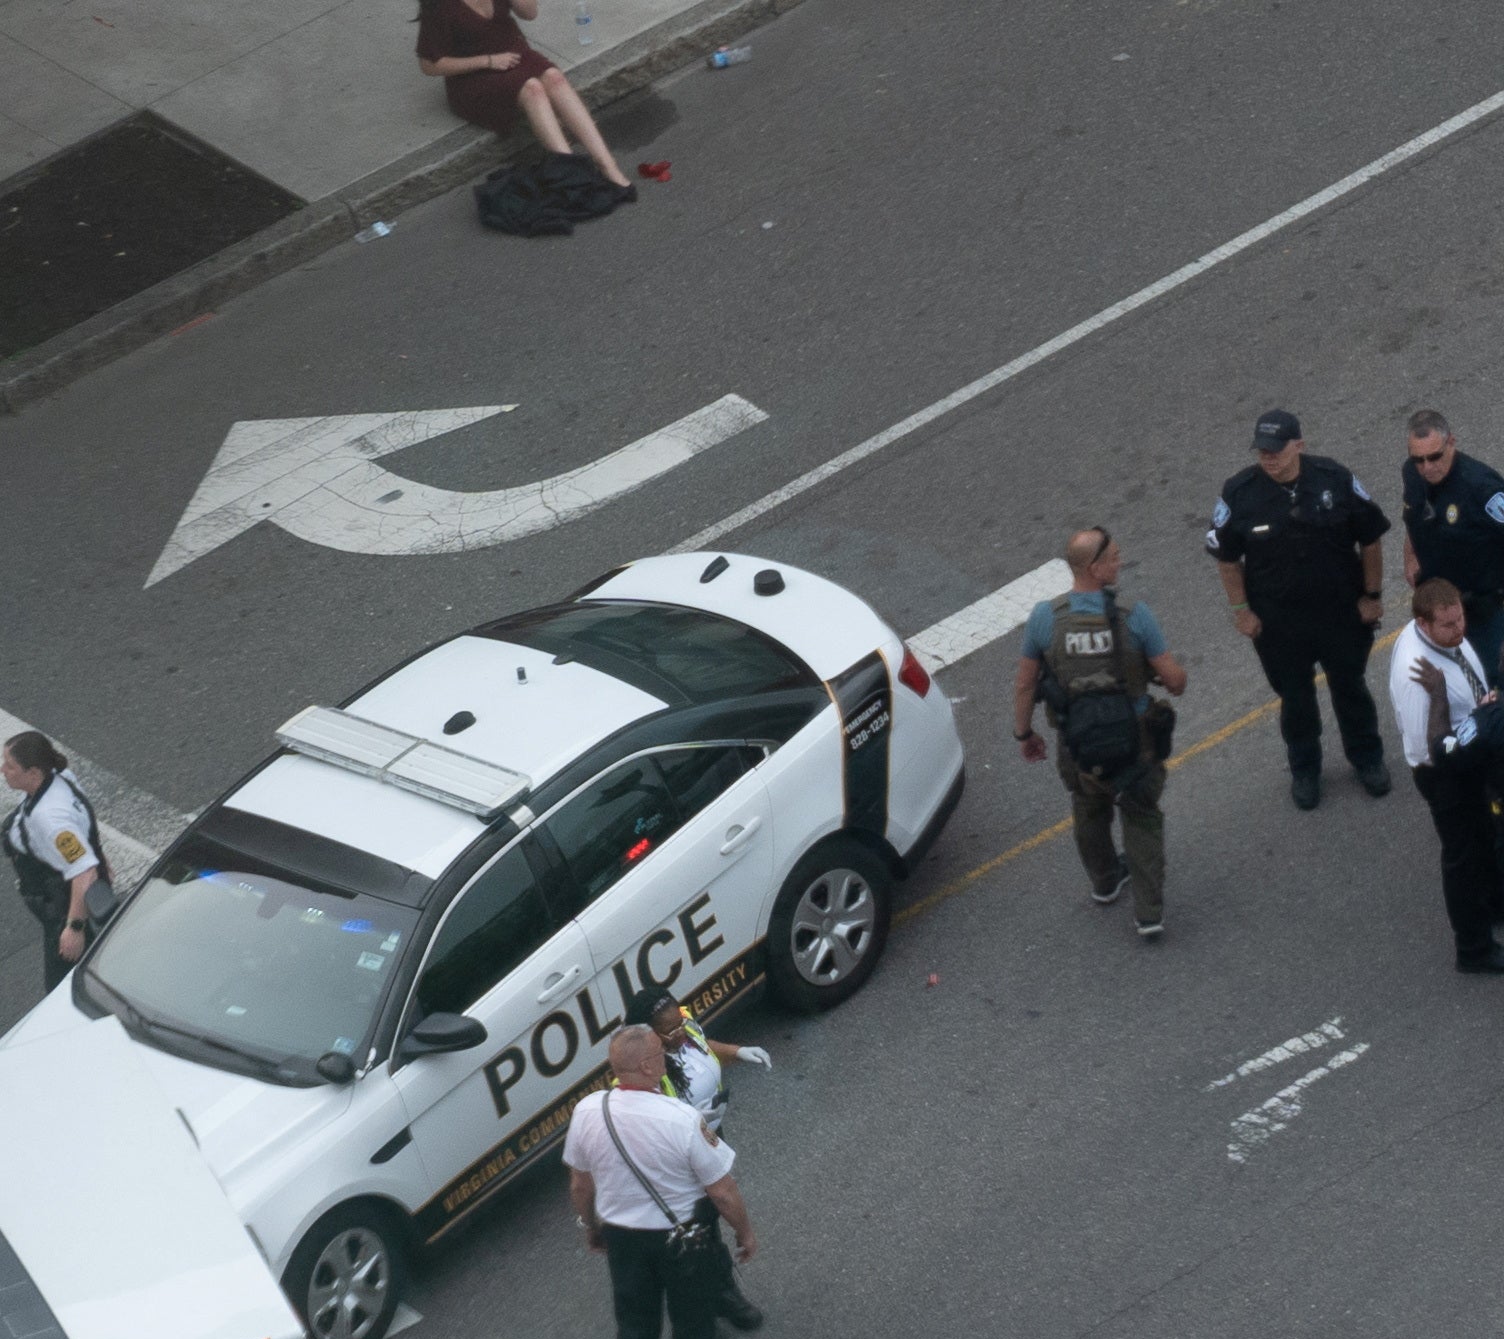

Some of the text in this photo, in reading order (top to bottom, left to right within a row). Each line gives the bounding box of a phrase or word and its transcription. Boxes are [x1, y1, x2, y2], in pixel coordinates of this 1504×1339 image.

[844, 699, 883, 734] EMERGENCY
[850, 710, 890, 750] 828-1234
[484, 893, 725, 1118] POLICE
[443, 1147, 517, 1213] VIRGINIA
